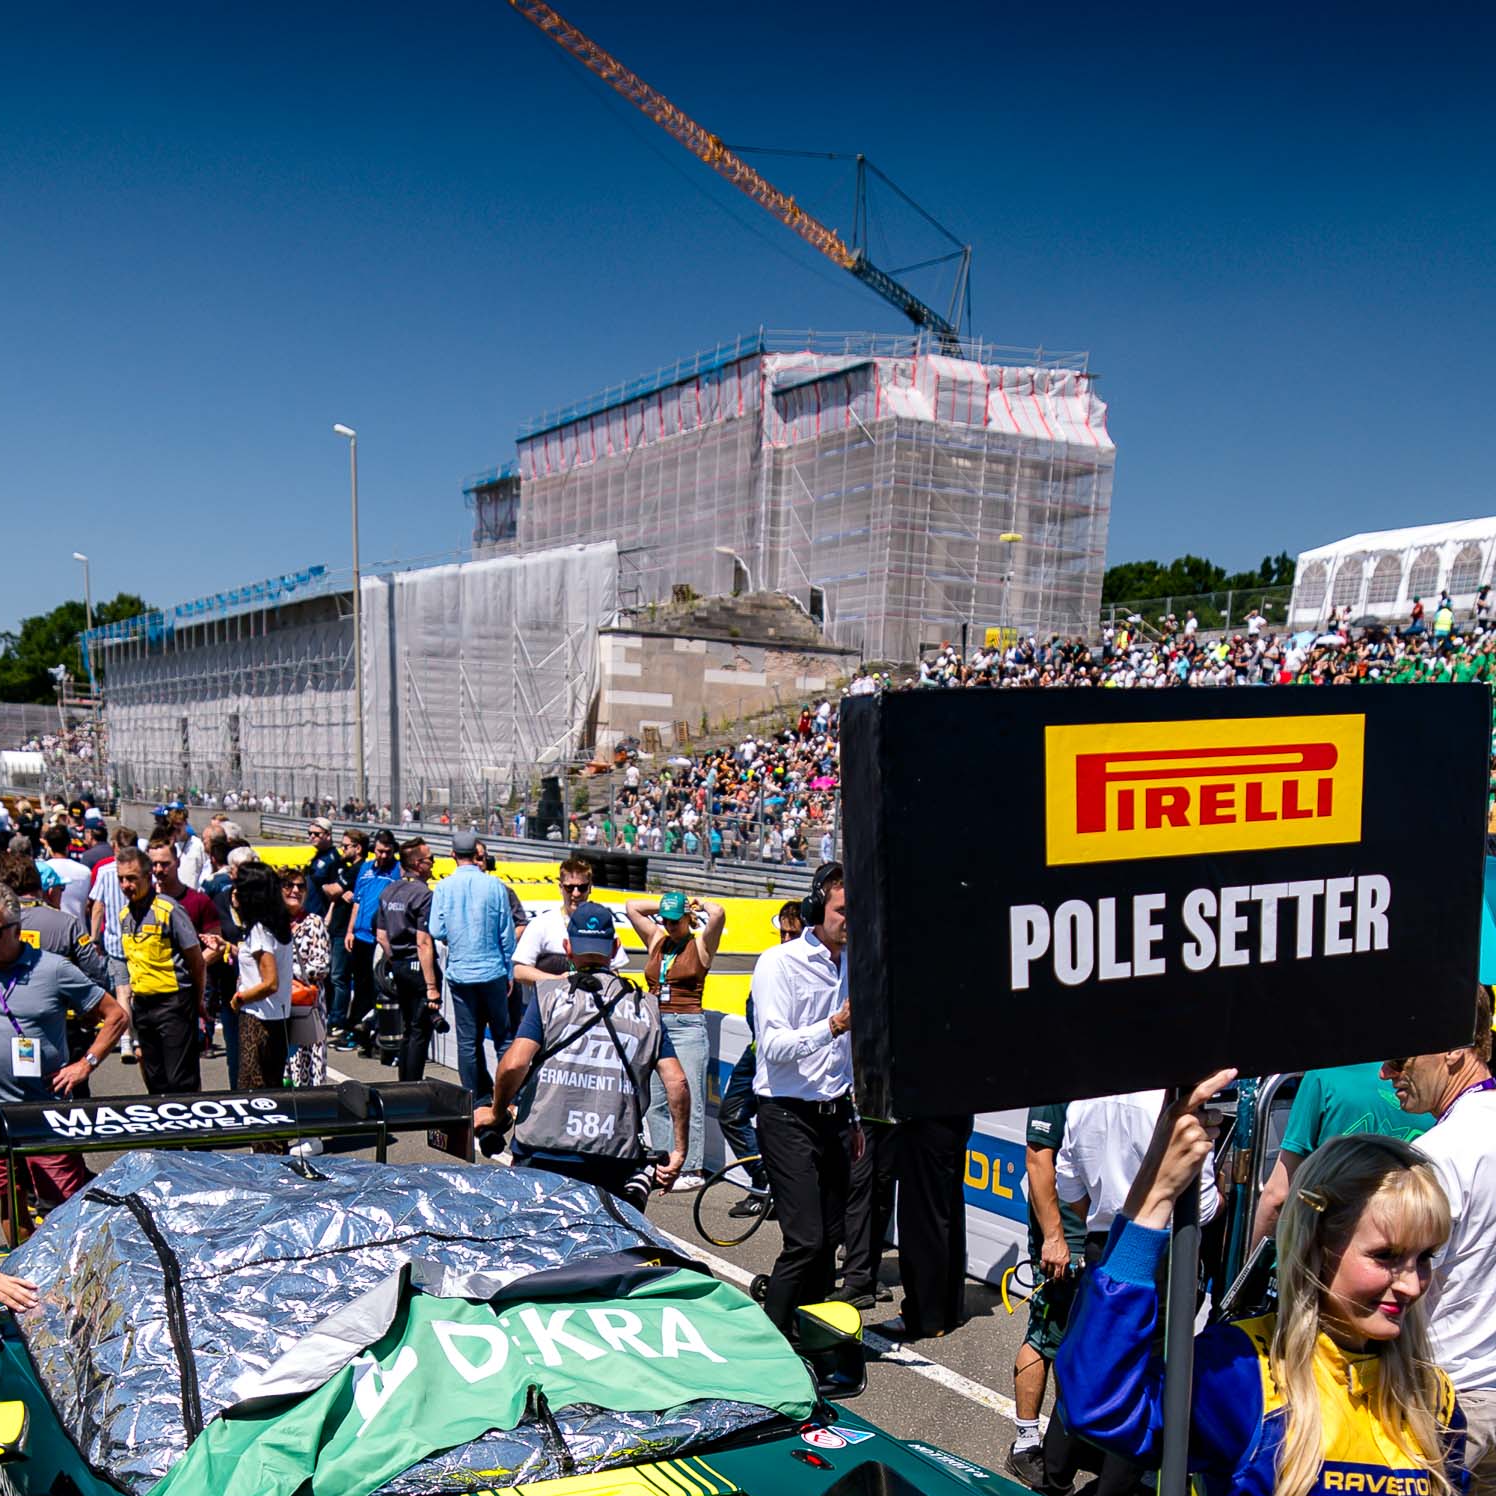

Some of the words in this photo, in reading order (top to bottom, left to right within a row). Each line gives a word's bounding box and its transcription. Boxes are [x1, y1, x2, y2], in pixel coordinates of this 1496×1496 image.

[1075, 742, 1338, 833] PIRELLI
[1010, 892, 1166, 991] POLE
[1182, 874, 1392, 972] SETTER
[538, 1067, 616, 1091] ERMANENT
[51, 1113, 296, 1138] WORKWEAR
[566, 1110, 616, 1140] 584
[431, 1306, 728, 1384] DKRA
